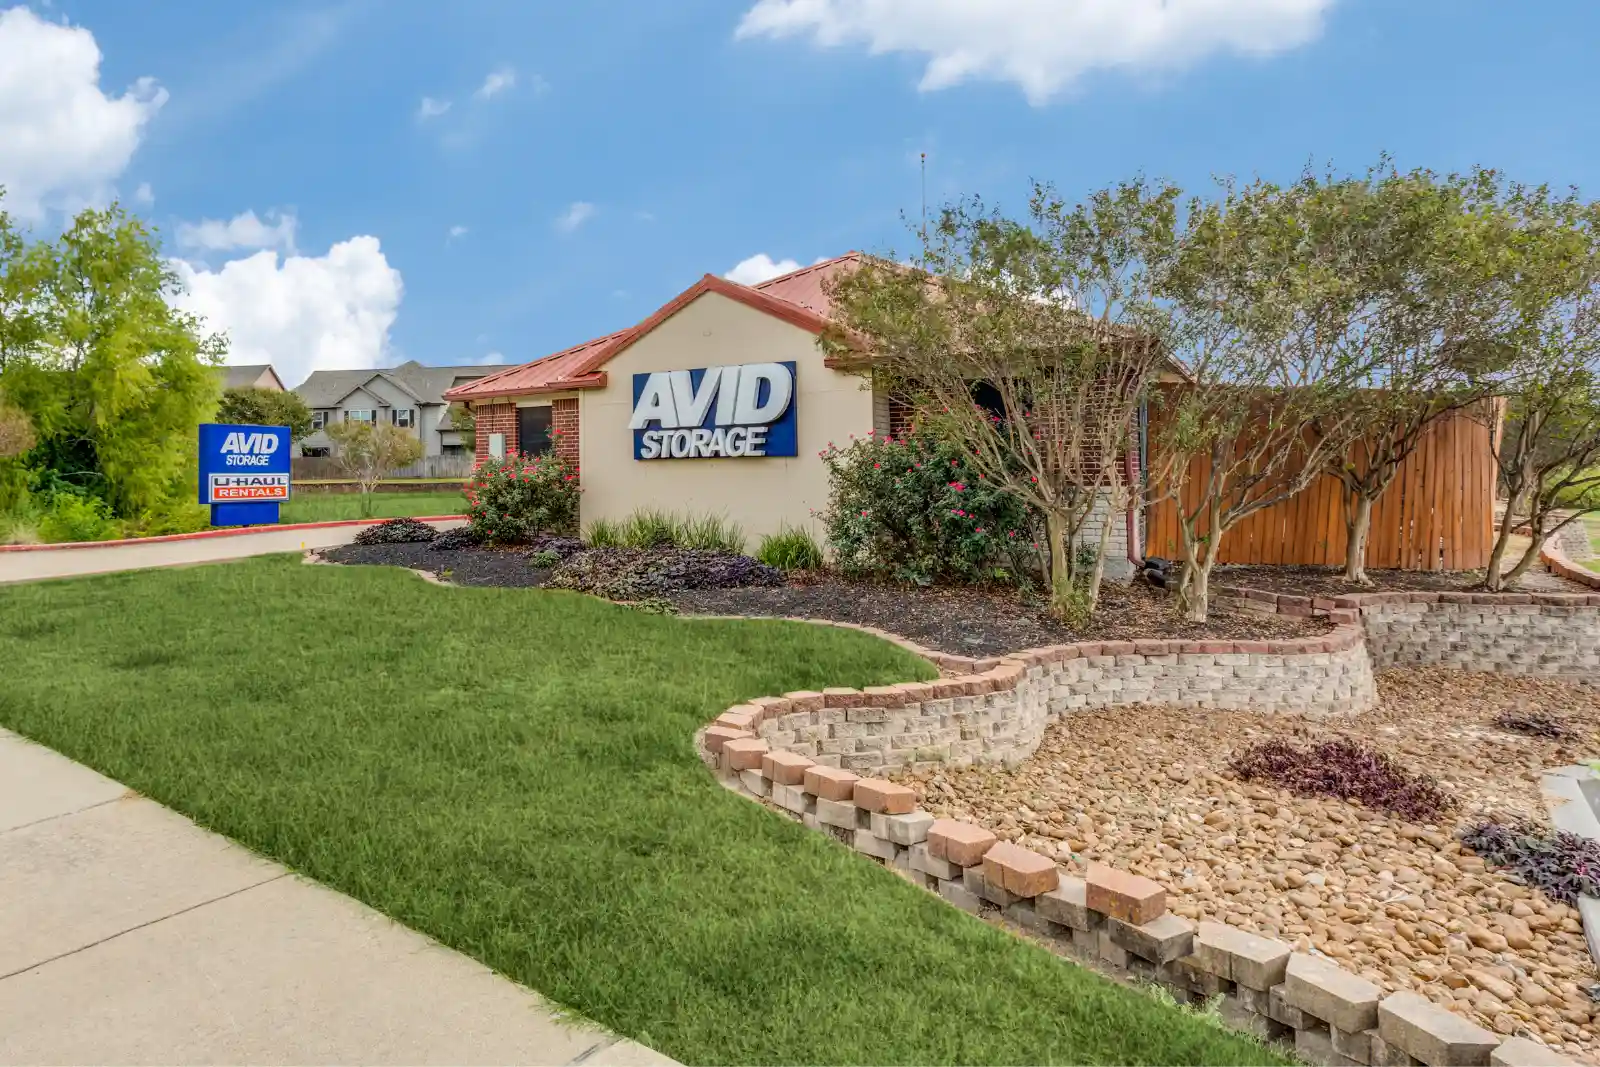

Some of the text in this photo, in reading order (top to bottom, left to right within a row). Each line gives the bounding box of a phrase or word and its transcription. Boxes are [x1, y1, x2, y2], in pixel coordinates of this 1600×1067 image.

[628, 362, 792, 429] AVID
[220, 432, 279, 453] AVID
[640, 427, 769, 458] STORAGE
[226, 455, 270, 465] STORAGE
[214, 477, 287, 486] U-HAUL
[219, 488, 283, 497] RENTALS
